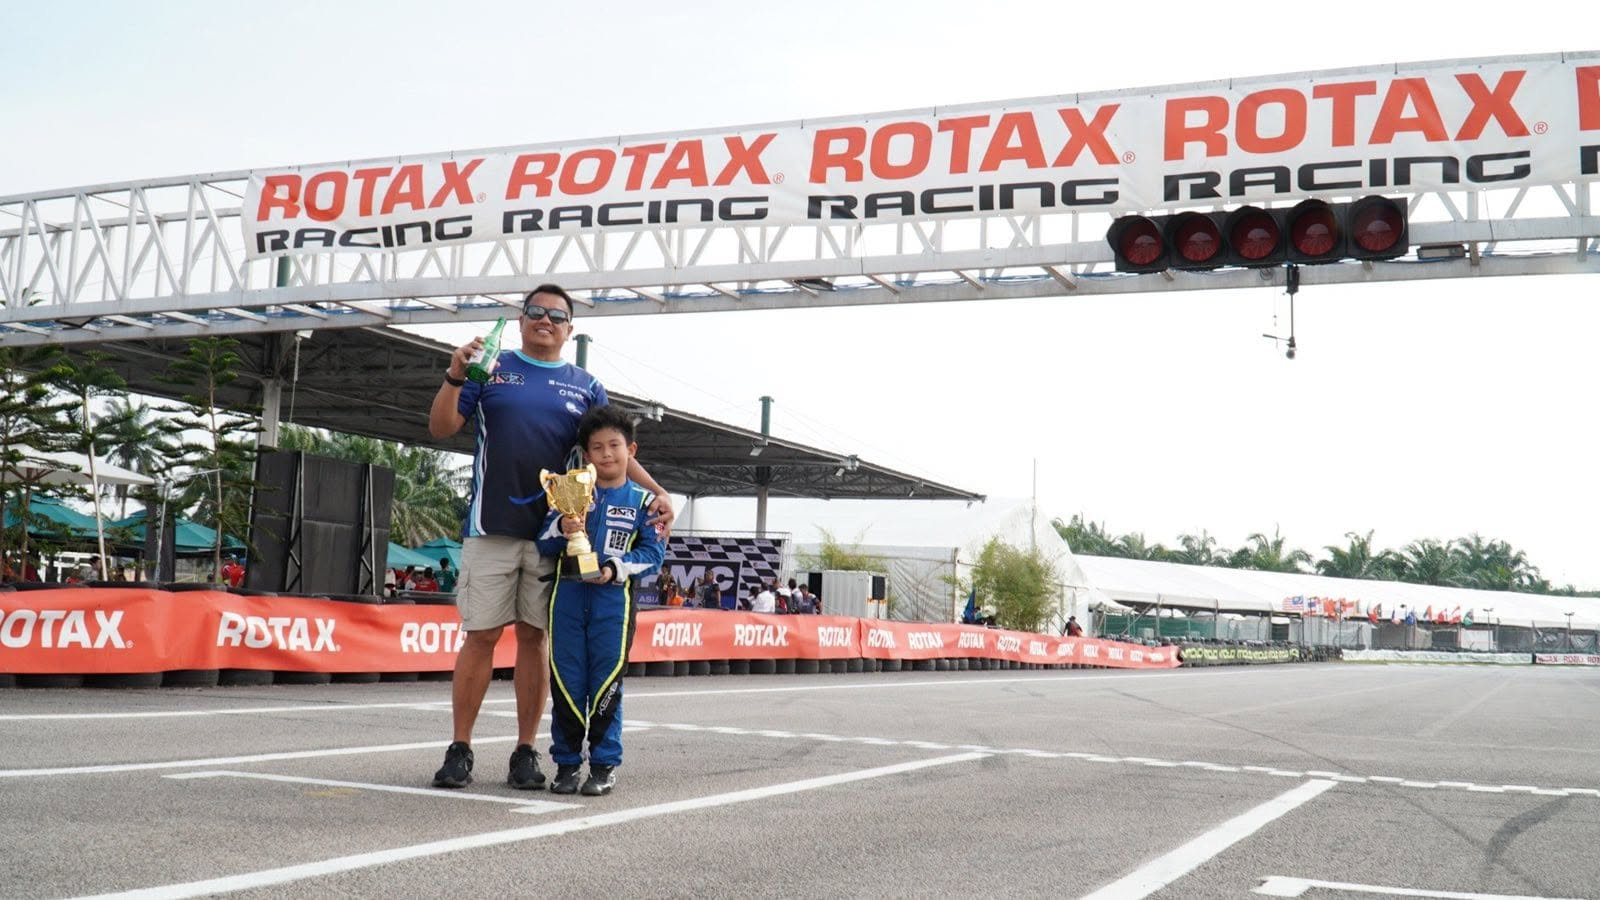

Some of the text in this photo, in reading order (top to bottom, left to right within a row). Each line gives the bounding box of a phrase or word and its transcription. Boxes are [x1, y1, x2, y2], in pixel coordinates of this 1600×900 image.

[257, 158, 485, 223] ROTAX
[505, 133, 778, 200] ROTAX
[809, 104, 1121, 184] ROTAX
[1163, 70, 1531, 162] ROTAX
[256, 214, 474, 254] RACING
[503, 196, 769, 234] RACING
[807, 178, 1120, 220] RACING
[1163, 150, 1531, 202] RACING
[0, 609, 127, 649] OTAX
[217, 612, 336, 652] ROTAX
[400, 622, 468, 653] ROTA
[651, 622, 702, 648] ROTAX
[734, 623, 789, 647] ROTAX
[817, 626, 853, 648] ROTAX
[867, 628, 896, 649] ROTAX
[907, 631, 944, 649] ROTAX
[957, 631, 985, 649] ROTAX
